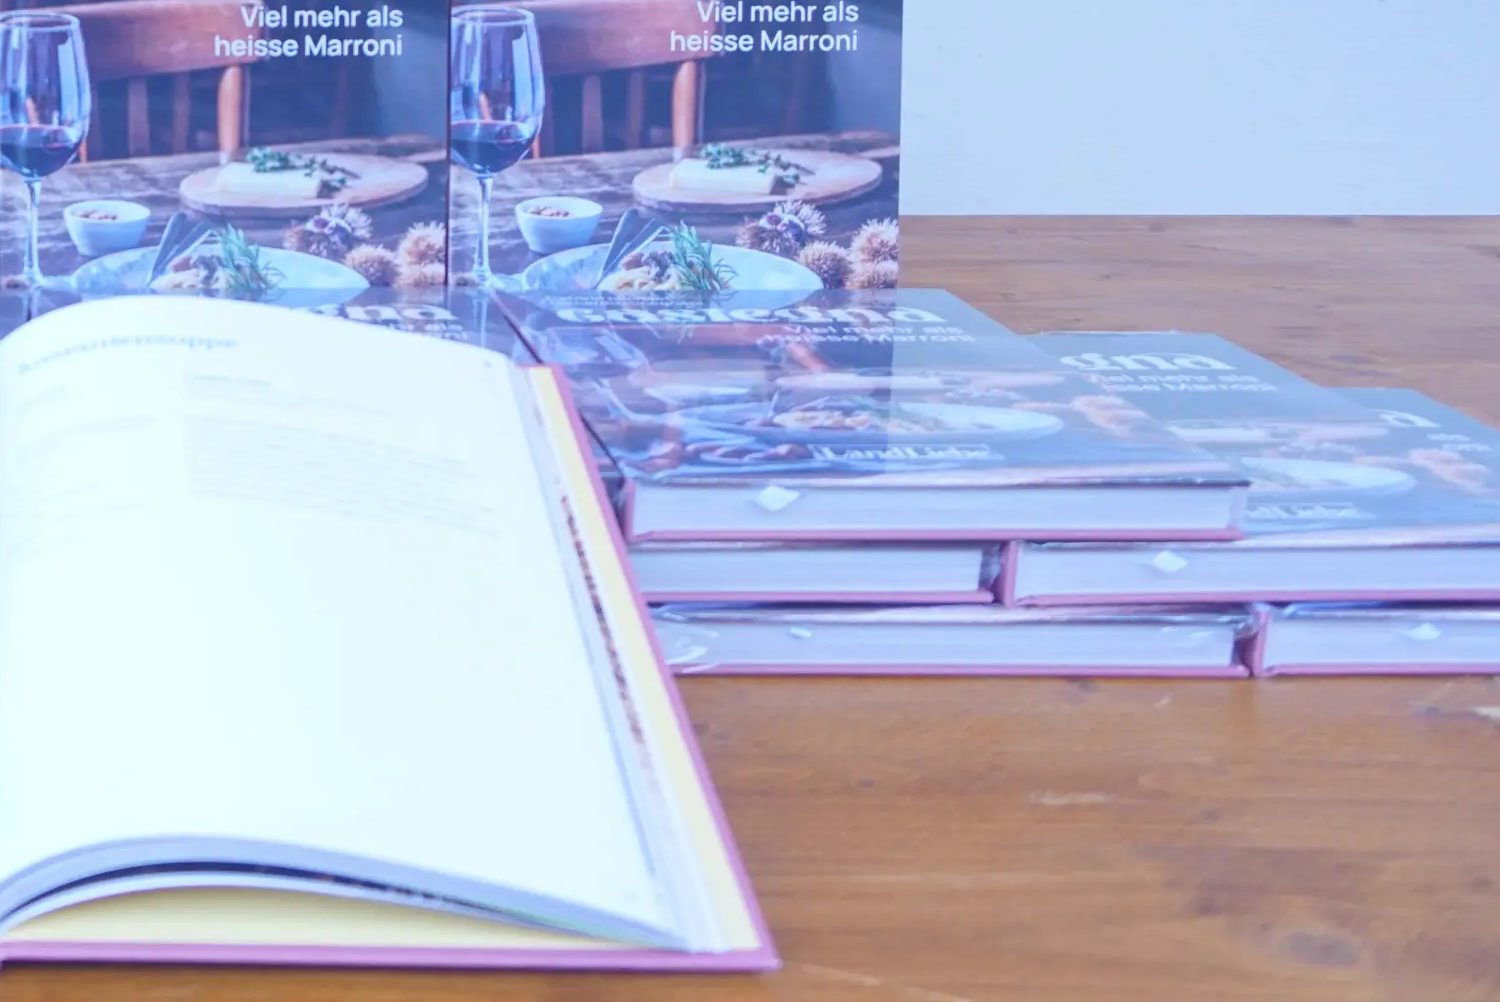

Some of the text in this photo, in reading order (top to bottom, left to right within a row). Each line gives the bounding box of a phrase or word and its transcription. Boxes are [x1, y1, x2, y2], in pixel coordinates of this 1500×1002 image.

[240, 6, 403, 28] Viel mehr als
[697, 1, 859, 23] Viel mehr als
[214, 35, 402, 56] heisse Marroni
[670, 30, 857, 51] heisse Marroni
